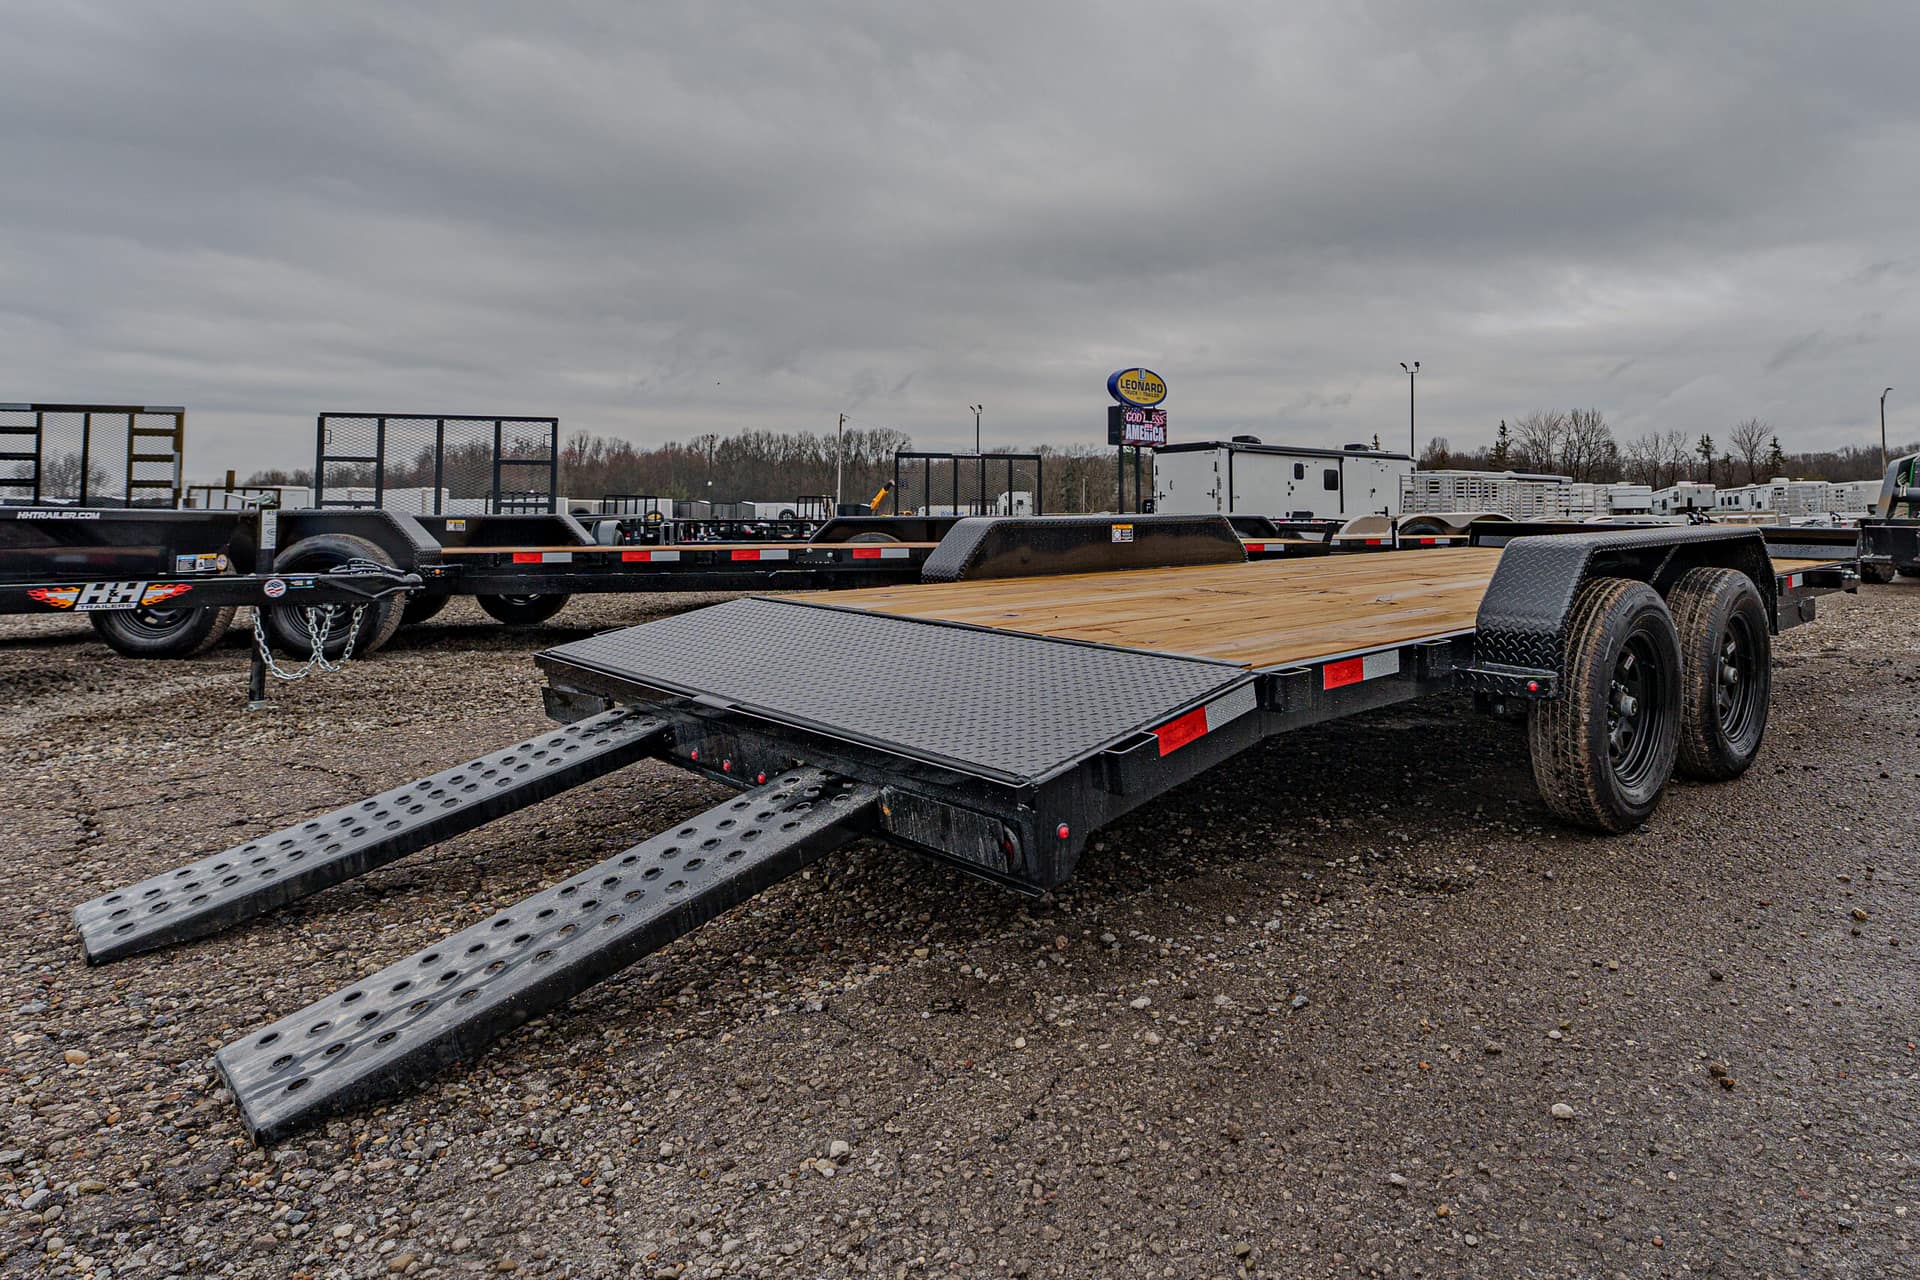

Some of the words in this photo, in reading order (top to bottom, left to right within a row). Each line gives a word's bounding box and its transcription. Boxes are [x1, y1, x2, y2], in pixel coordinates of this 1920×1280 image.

[1120, 379, 1163, 393] LEONARD
[1126, 412, 1142, 423] GOD
[16, 511, 100, 520] HHTRAILER.COM
